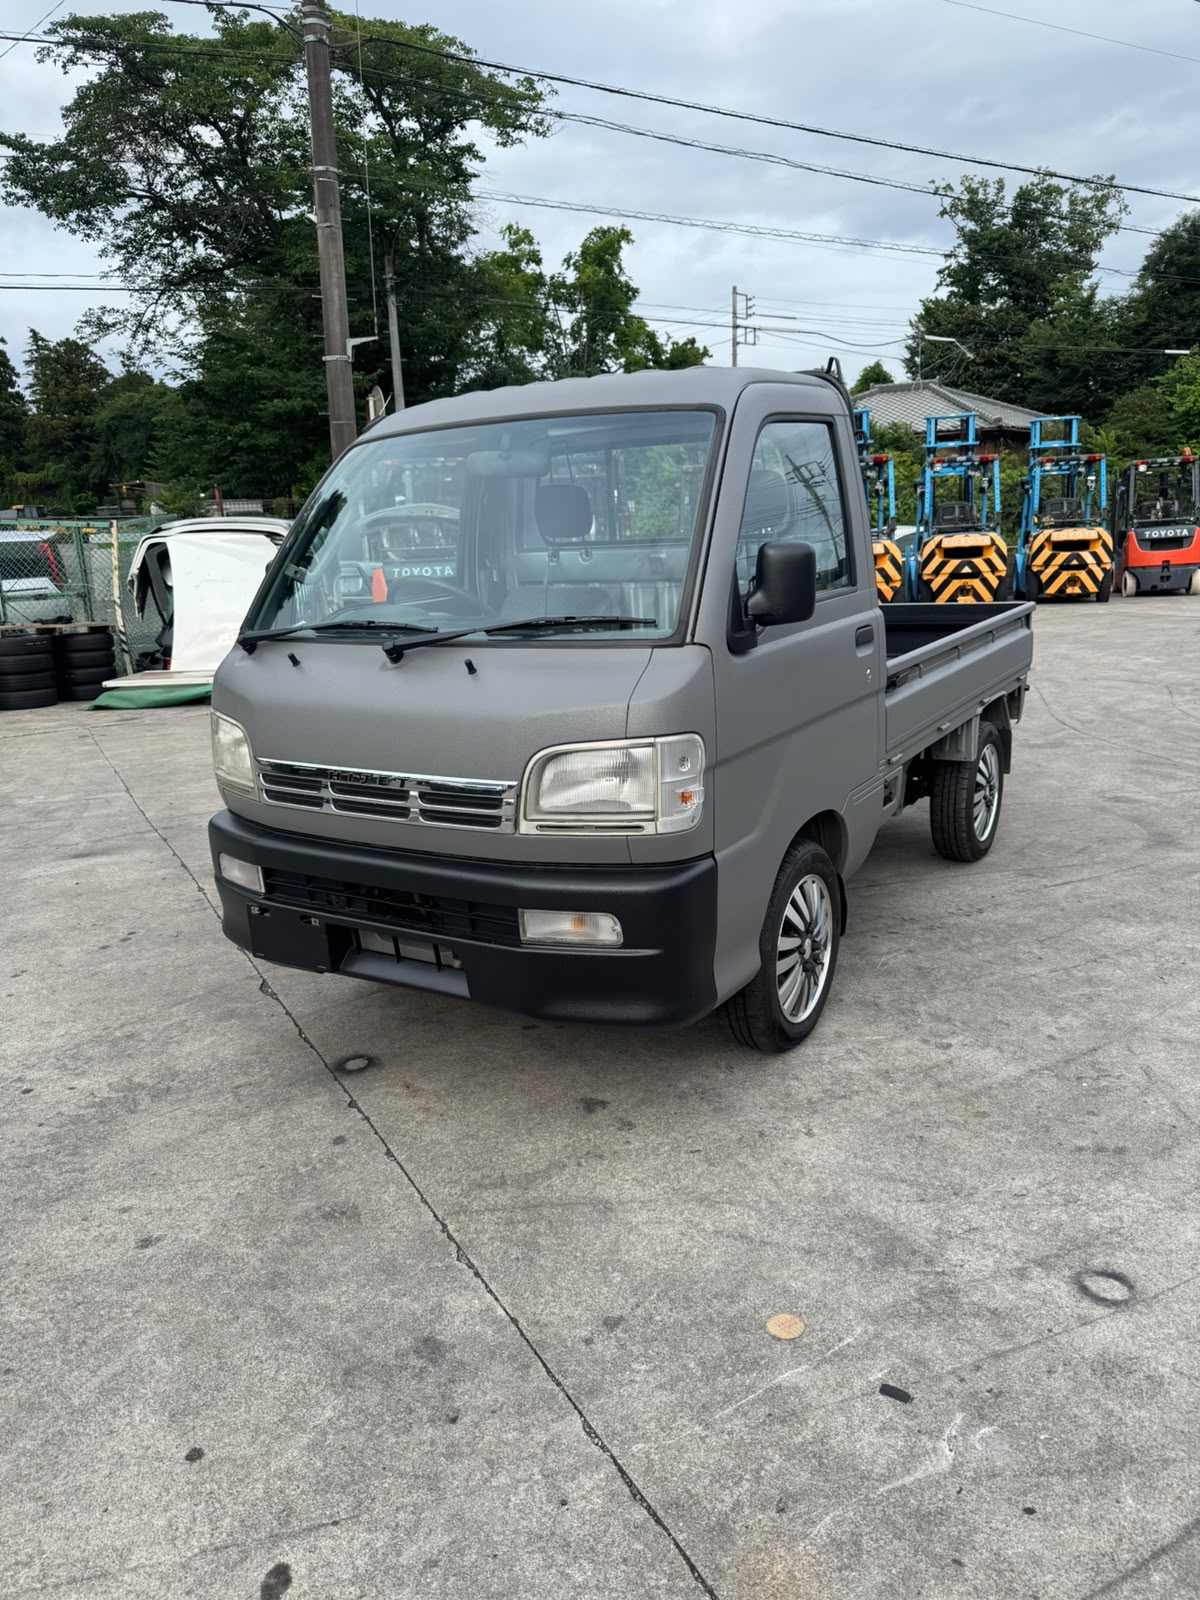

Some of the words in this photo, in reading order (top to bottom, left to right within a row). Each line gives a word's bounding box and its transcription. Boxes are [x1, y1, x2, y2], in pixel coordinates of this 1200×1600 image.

[1053, 531, 1097, 540] TOYOTA
[1144, 528, 1189, 539] TOYOTA
[392, 566, 454, 578] TOYOTA
[328, 770, 409, 788] HIJET
